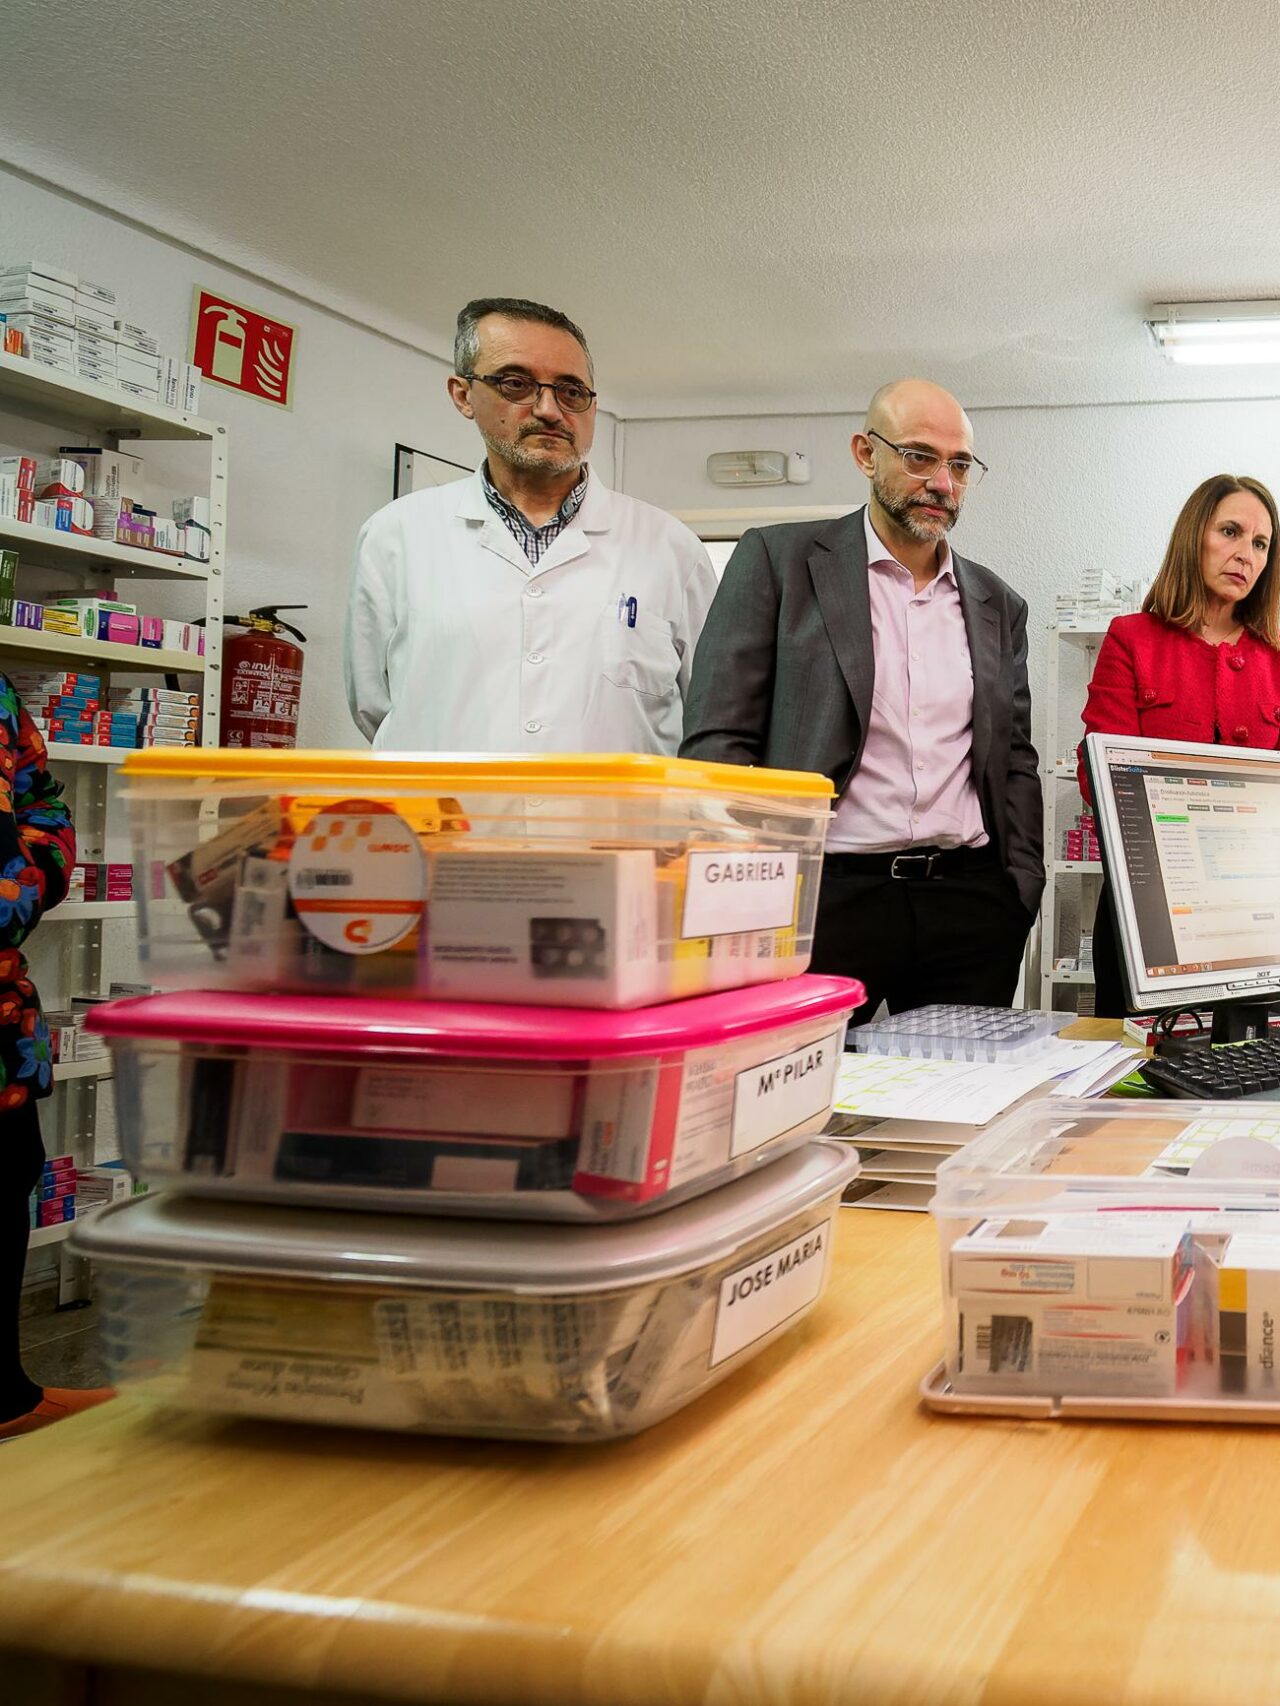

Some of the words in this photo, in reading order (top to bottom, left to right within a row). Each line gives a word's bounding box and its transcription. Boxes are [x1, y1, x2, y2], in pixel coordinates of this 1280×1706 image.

[705, 861, 785, 884] GABRIELA
[782, 1050, 824, 1085] PILAR
[727, 1264, 773, 1307] JOSE
[776, 1235, 823, 1281] MARIA
